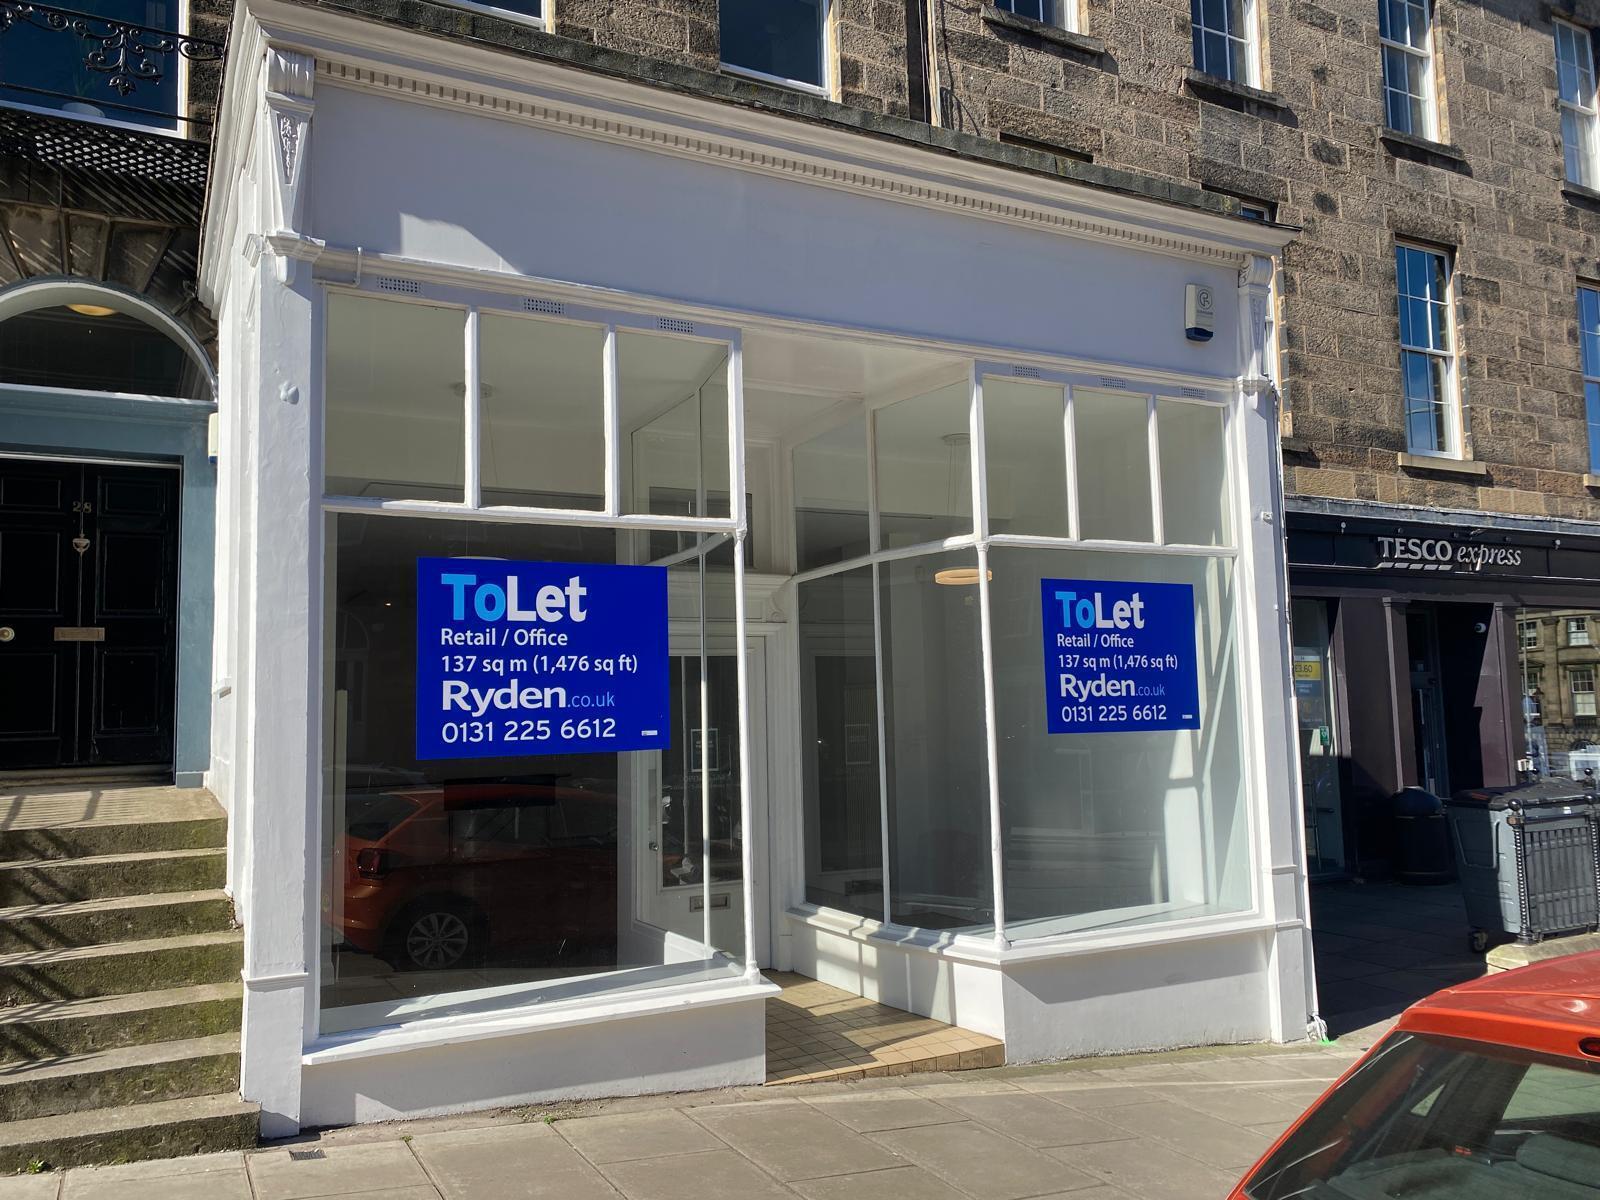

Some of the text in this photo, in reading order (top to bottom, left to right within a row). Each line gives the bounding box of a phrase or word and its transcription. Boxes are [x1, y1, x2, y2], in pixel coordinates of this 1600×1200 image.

[72, 501, 92, 514] 28
[1377, 536, 1522, 571] TESCO express
[440, 627, 568, 647] Retail / Office
[1057, 633, 1135, 648] Retail / Office
[441, 653, 639, 677] 137 sq m (1,476 sq ft)
[1058, 653, 1178, 672] 137 sq m (1,476 sq ft)
[442, 677, 616, 718] Ryden.co.uk
[1059, 672, 1166, 703] Ryden.co.uk
[1061, 704, 1167, 723] 0131 225 6612
[441, 717, 617, 744] 0131 225 6612
